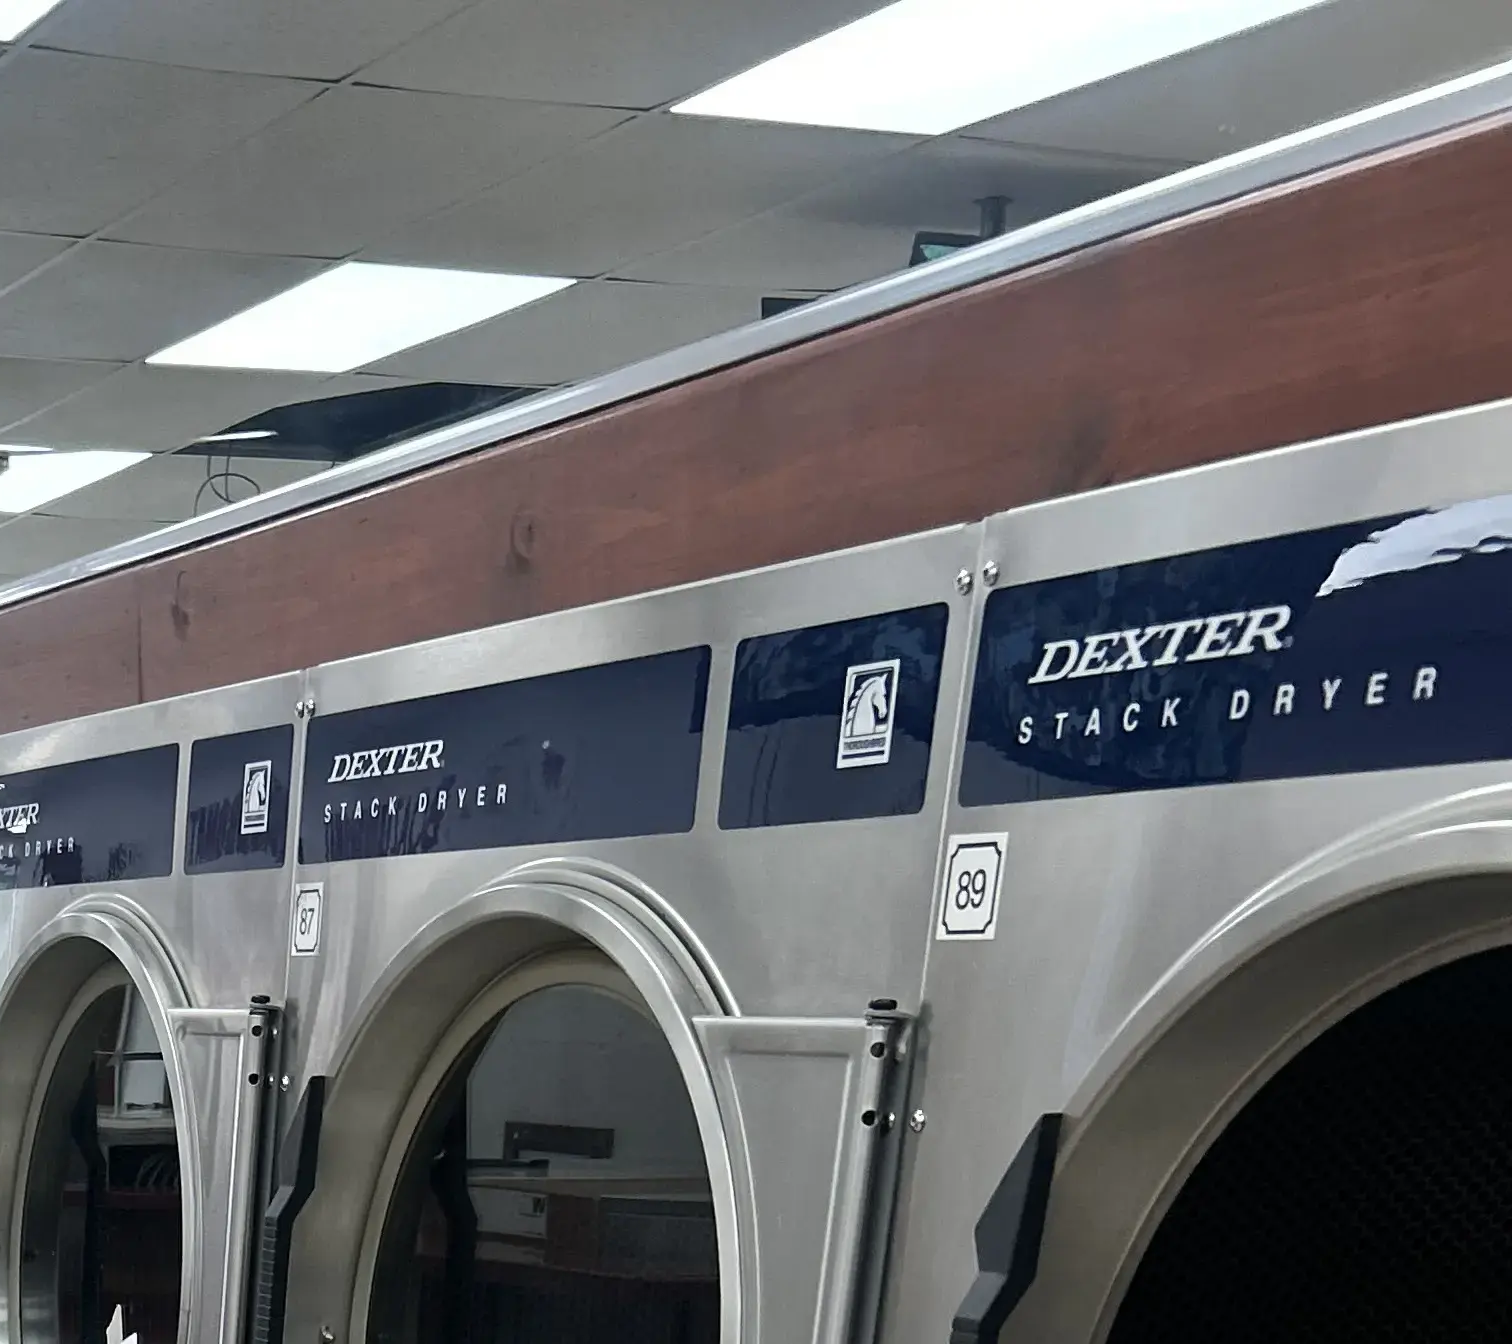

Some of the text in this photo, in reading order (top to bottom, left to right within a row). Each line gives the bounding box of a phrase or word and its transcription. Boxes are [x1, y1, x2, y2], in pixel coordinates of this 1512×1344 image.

[1028, 604, 1291, 685] DEXTER
[1018, 666, 1439, 745] STACK DRYER
[328, 739, 444, 783] DEXTER
[323, 783, 507, 823] STACK DRYER
[24, 836, 75, 857] DRYER
[954, 870, 986, 911] 89
[299, 907, 315, 935] 87
